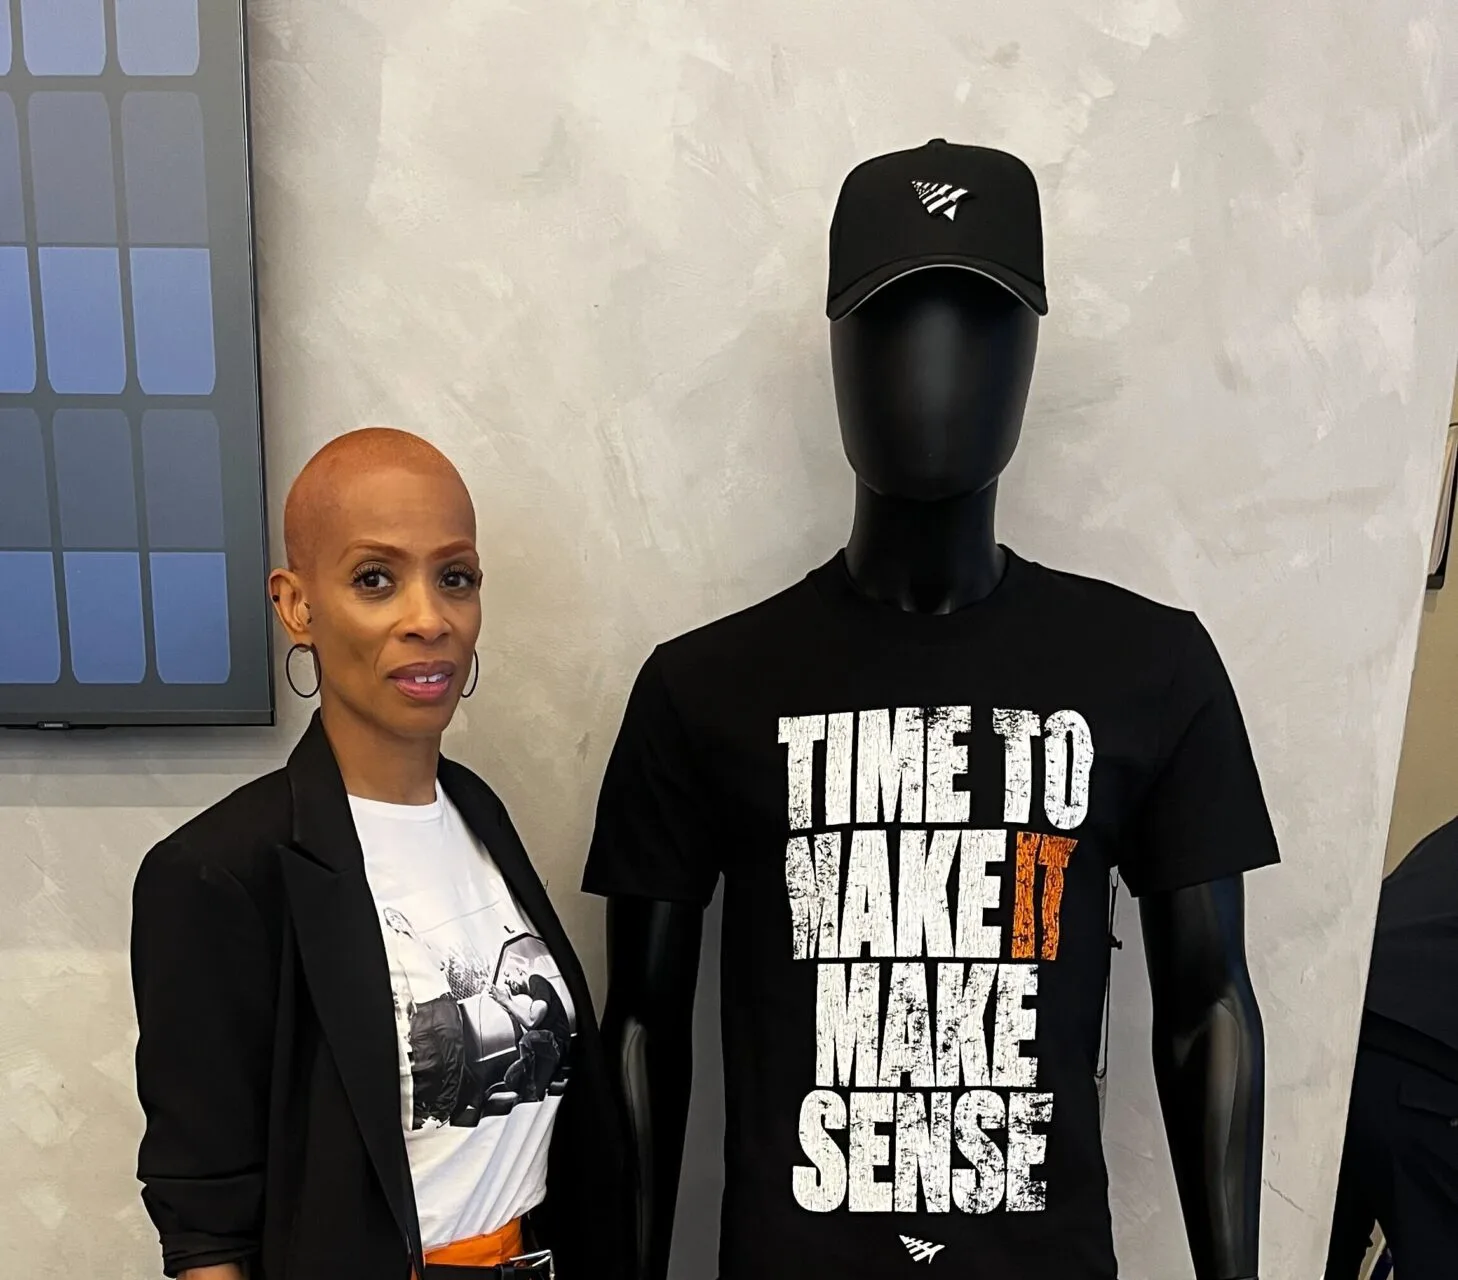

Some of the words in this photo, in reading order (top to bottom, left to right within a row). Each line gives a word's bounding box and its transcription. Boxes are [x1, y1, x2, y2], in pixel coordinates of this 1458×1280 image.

[777, 705, 972, 831] TIME
[992, 708, 1095, 830] TO
[785, 829, 1008, 960] MAKE
[1011, 831, 1079, 961] IT
[815, 962, 1039, 1088] MAKE
[792, 1089, 1054, 1215] SENSE
